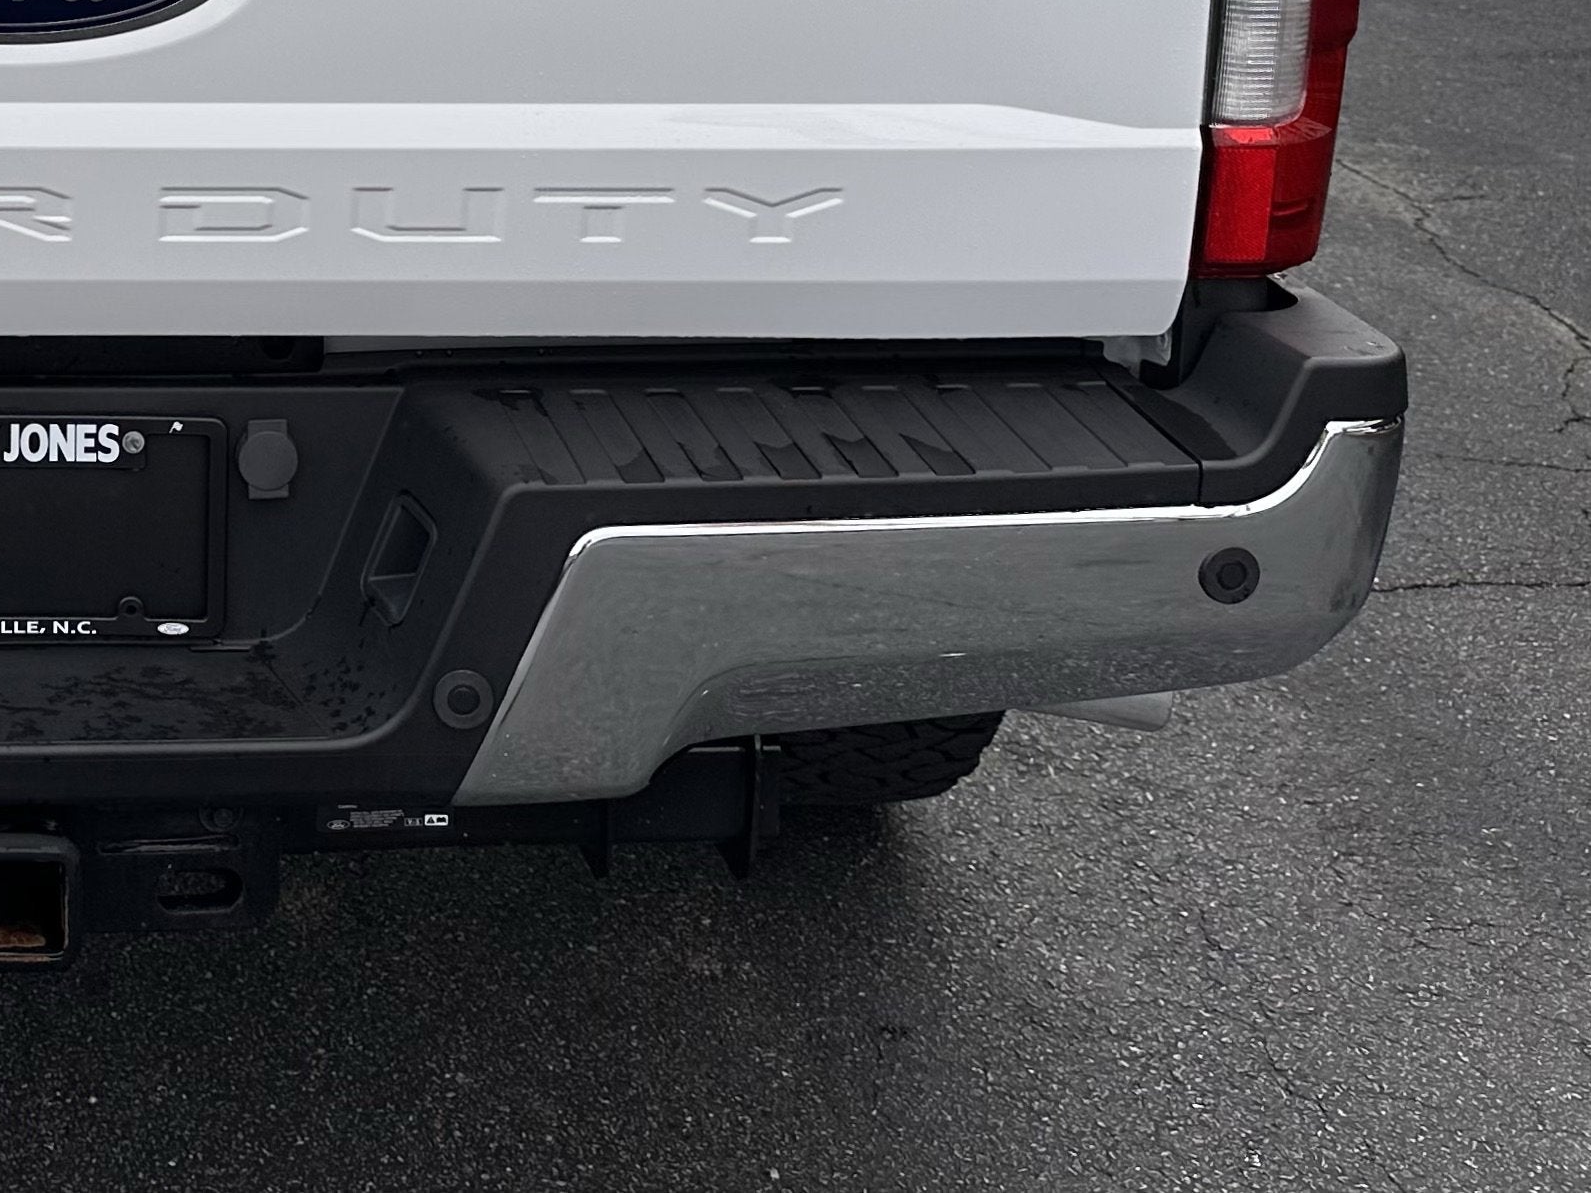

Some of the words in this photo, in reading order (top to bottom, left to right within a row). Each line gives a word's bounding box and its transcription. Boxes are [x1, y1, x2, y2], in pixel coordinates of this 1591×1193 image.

[157, 185, 845, 244] DUTY
[3, 423, 120, 463] JONES
[52, 620, 97, 635] N.C.
